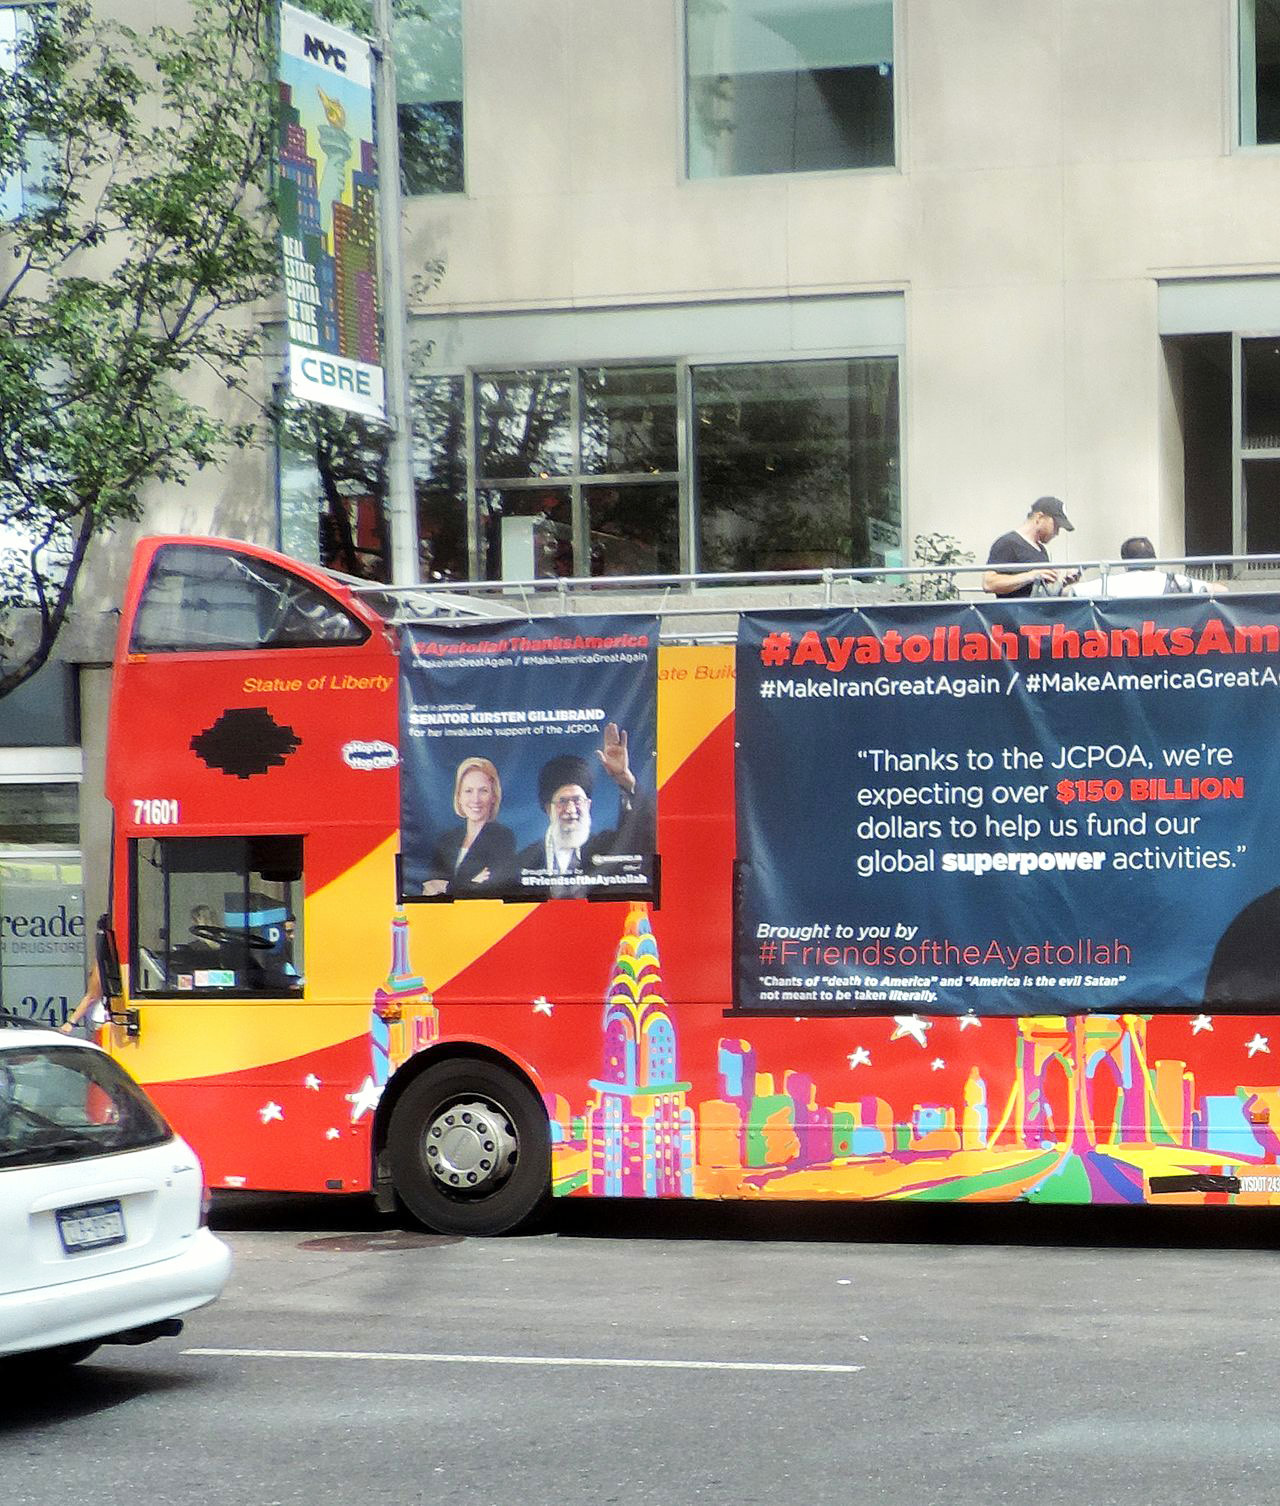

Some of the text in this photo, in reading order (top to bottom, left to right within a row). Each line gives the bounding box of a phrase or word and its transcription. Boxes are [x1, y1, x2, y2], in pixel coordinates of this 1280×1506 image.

[304, 33, 346, 72] NYC
[284, 255, 316, 285] ESTATE
[286, 275, 322, 307] CAPITAL
[301, 357, 371, 395] CBRE
[414, 635, 648, 657] #AyatollahThanksAmerica
[412, 656, 513, 669] #MakeIranGreatAgain
[523, 653, 647, 665] #MakeAmericaGreatAgain
[242, 675, 393, 693] Statue of Liberty
[760, 674, 1000, 698] #MakeIranGreatAgain
[1006, 672, 1020, 695] /
[409, 709, 605, 725] SENATOR KIRSTEN GILLIBRAND
[409, 727, 427, 737] for
[445, 726, 493, 736] invaluable
[495, 725, 532, 738] support
[534, 724, 544, 734] of
[546, 724, 563, 734] the
[565, 723, 600, 734] JCPOA
[857, 743, 1234, 771] “Thanks to the JCPOA, we’re
[857, 777, 1245, 809] expecting over $150 BILLION
[133, 799, 179, 825] 71601
[856, 812, 1201, 842] dollars to help us fund our
[856, 845, 1247, 877] global superpower activities.”
[757, 923, 918, 941] Brought to you by
[759, 938, 1132, 971] #FriendsoftheAyatollah
[805, 976, 820, 987] of
[822, 976, 862, 987] “death
[864, 977, 878, 987] to
[880, 975, 938, 987] America”
[939, 976, 963, 987] and
[965, 976, 1021, 987] “America
[1023, 976, 1033, 987] is
[1035, 976, 1057, 987] the
[1058, 975, 1082, 987] evil
[1083, 975, 1127, 987] Satan”
[760, 990, 938, 1002] not meant to be taken literally.
